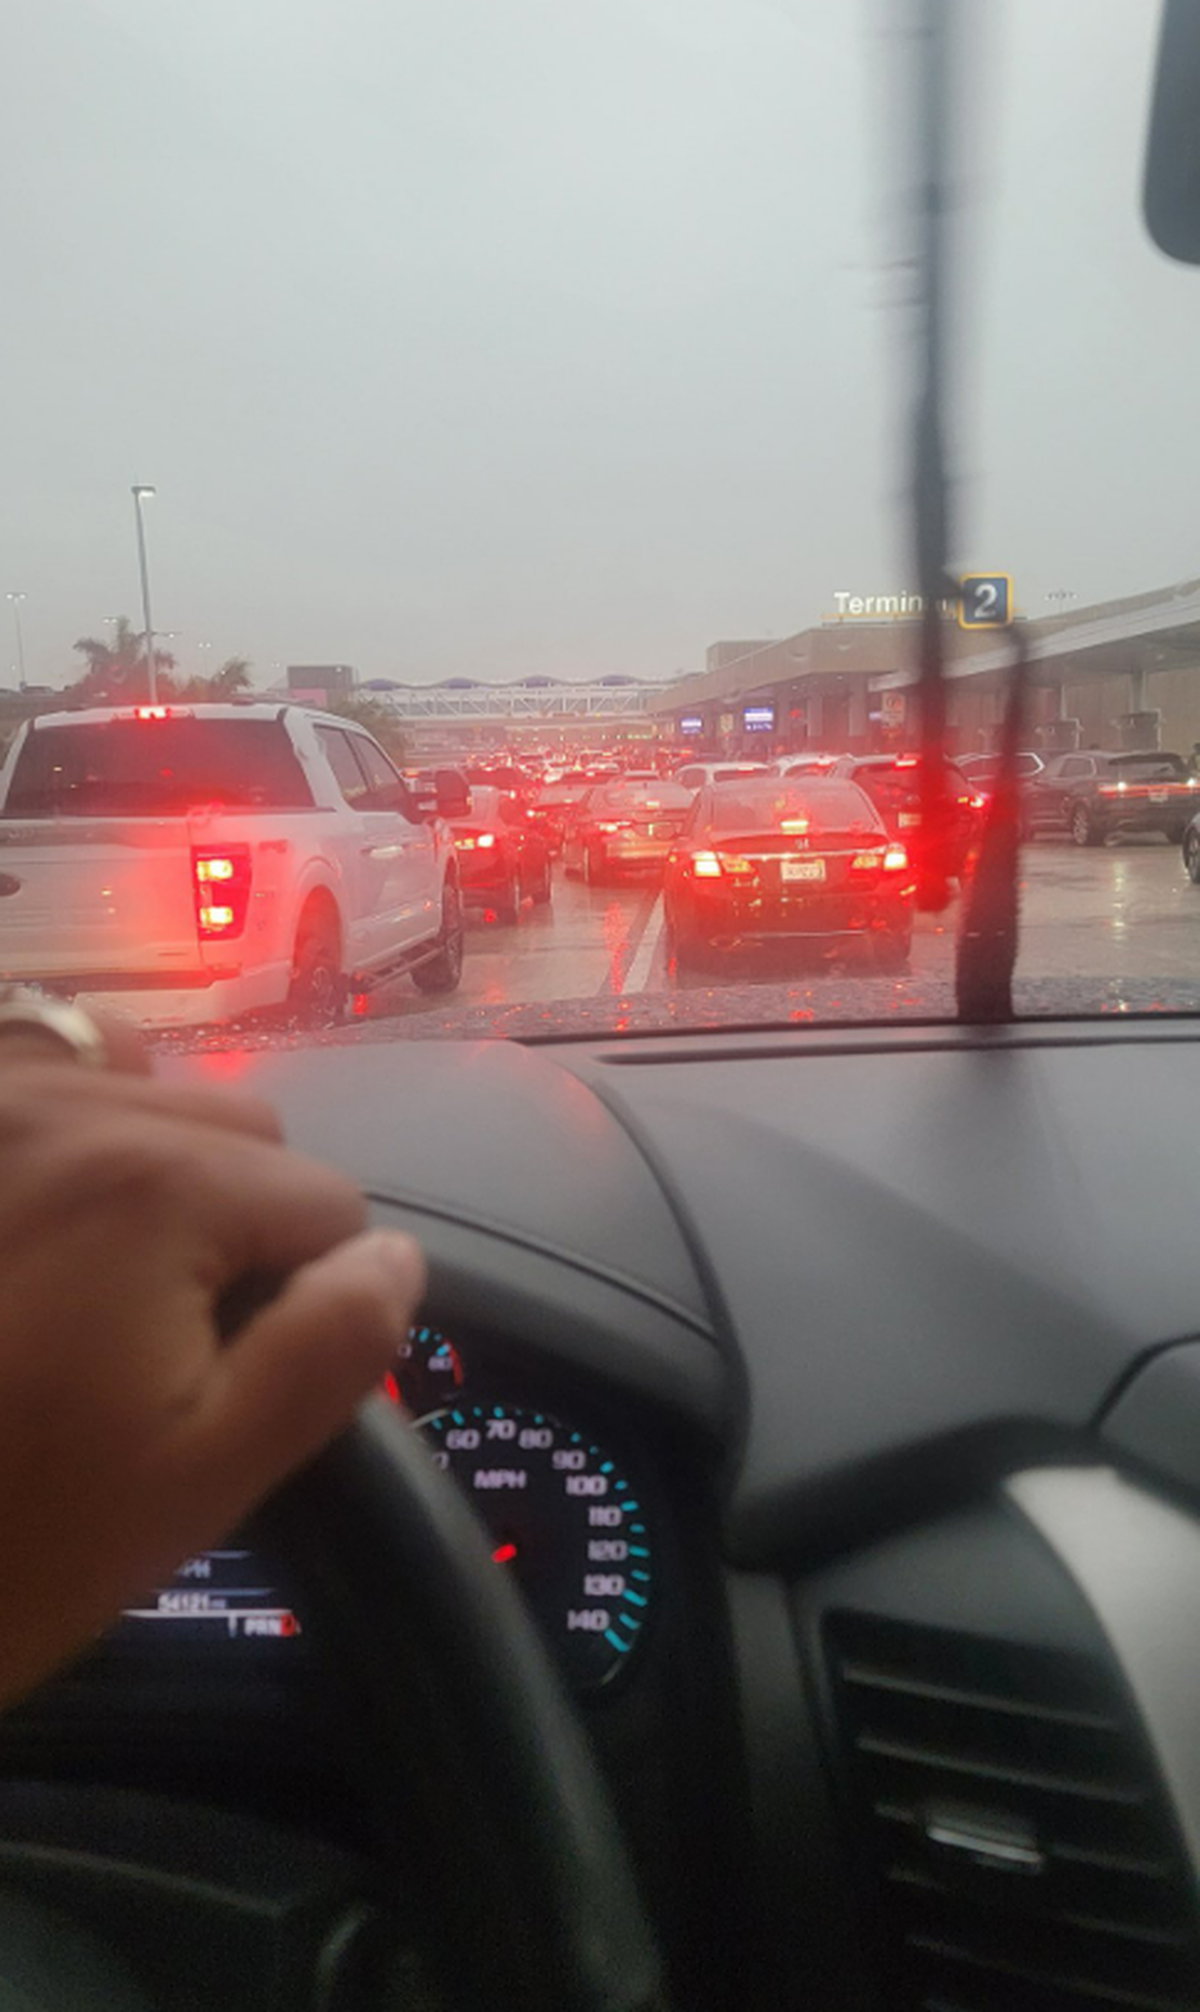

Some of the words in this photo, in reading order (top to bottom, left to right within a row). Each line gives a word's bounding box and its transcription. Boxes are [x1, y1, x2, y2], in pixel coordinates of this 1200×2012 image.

[974, 583, 998, 618] 2
[486, 1418, 516, 1440] 70
[519, 1428, 553, 1449] 80
[552, 1449, 586, 1470] 90
[473, 1469, 527, 1489] MPH
[565, 1475, 608, 1496] 100
[588, 1505, 623, 1527] 110
[587, 1539, 628, 1561] 120
[584, 1573, 625, 1596] 130
[567, 1609, 609, 1631] 140
